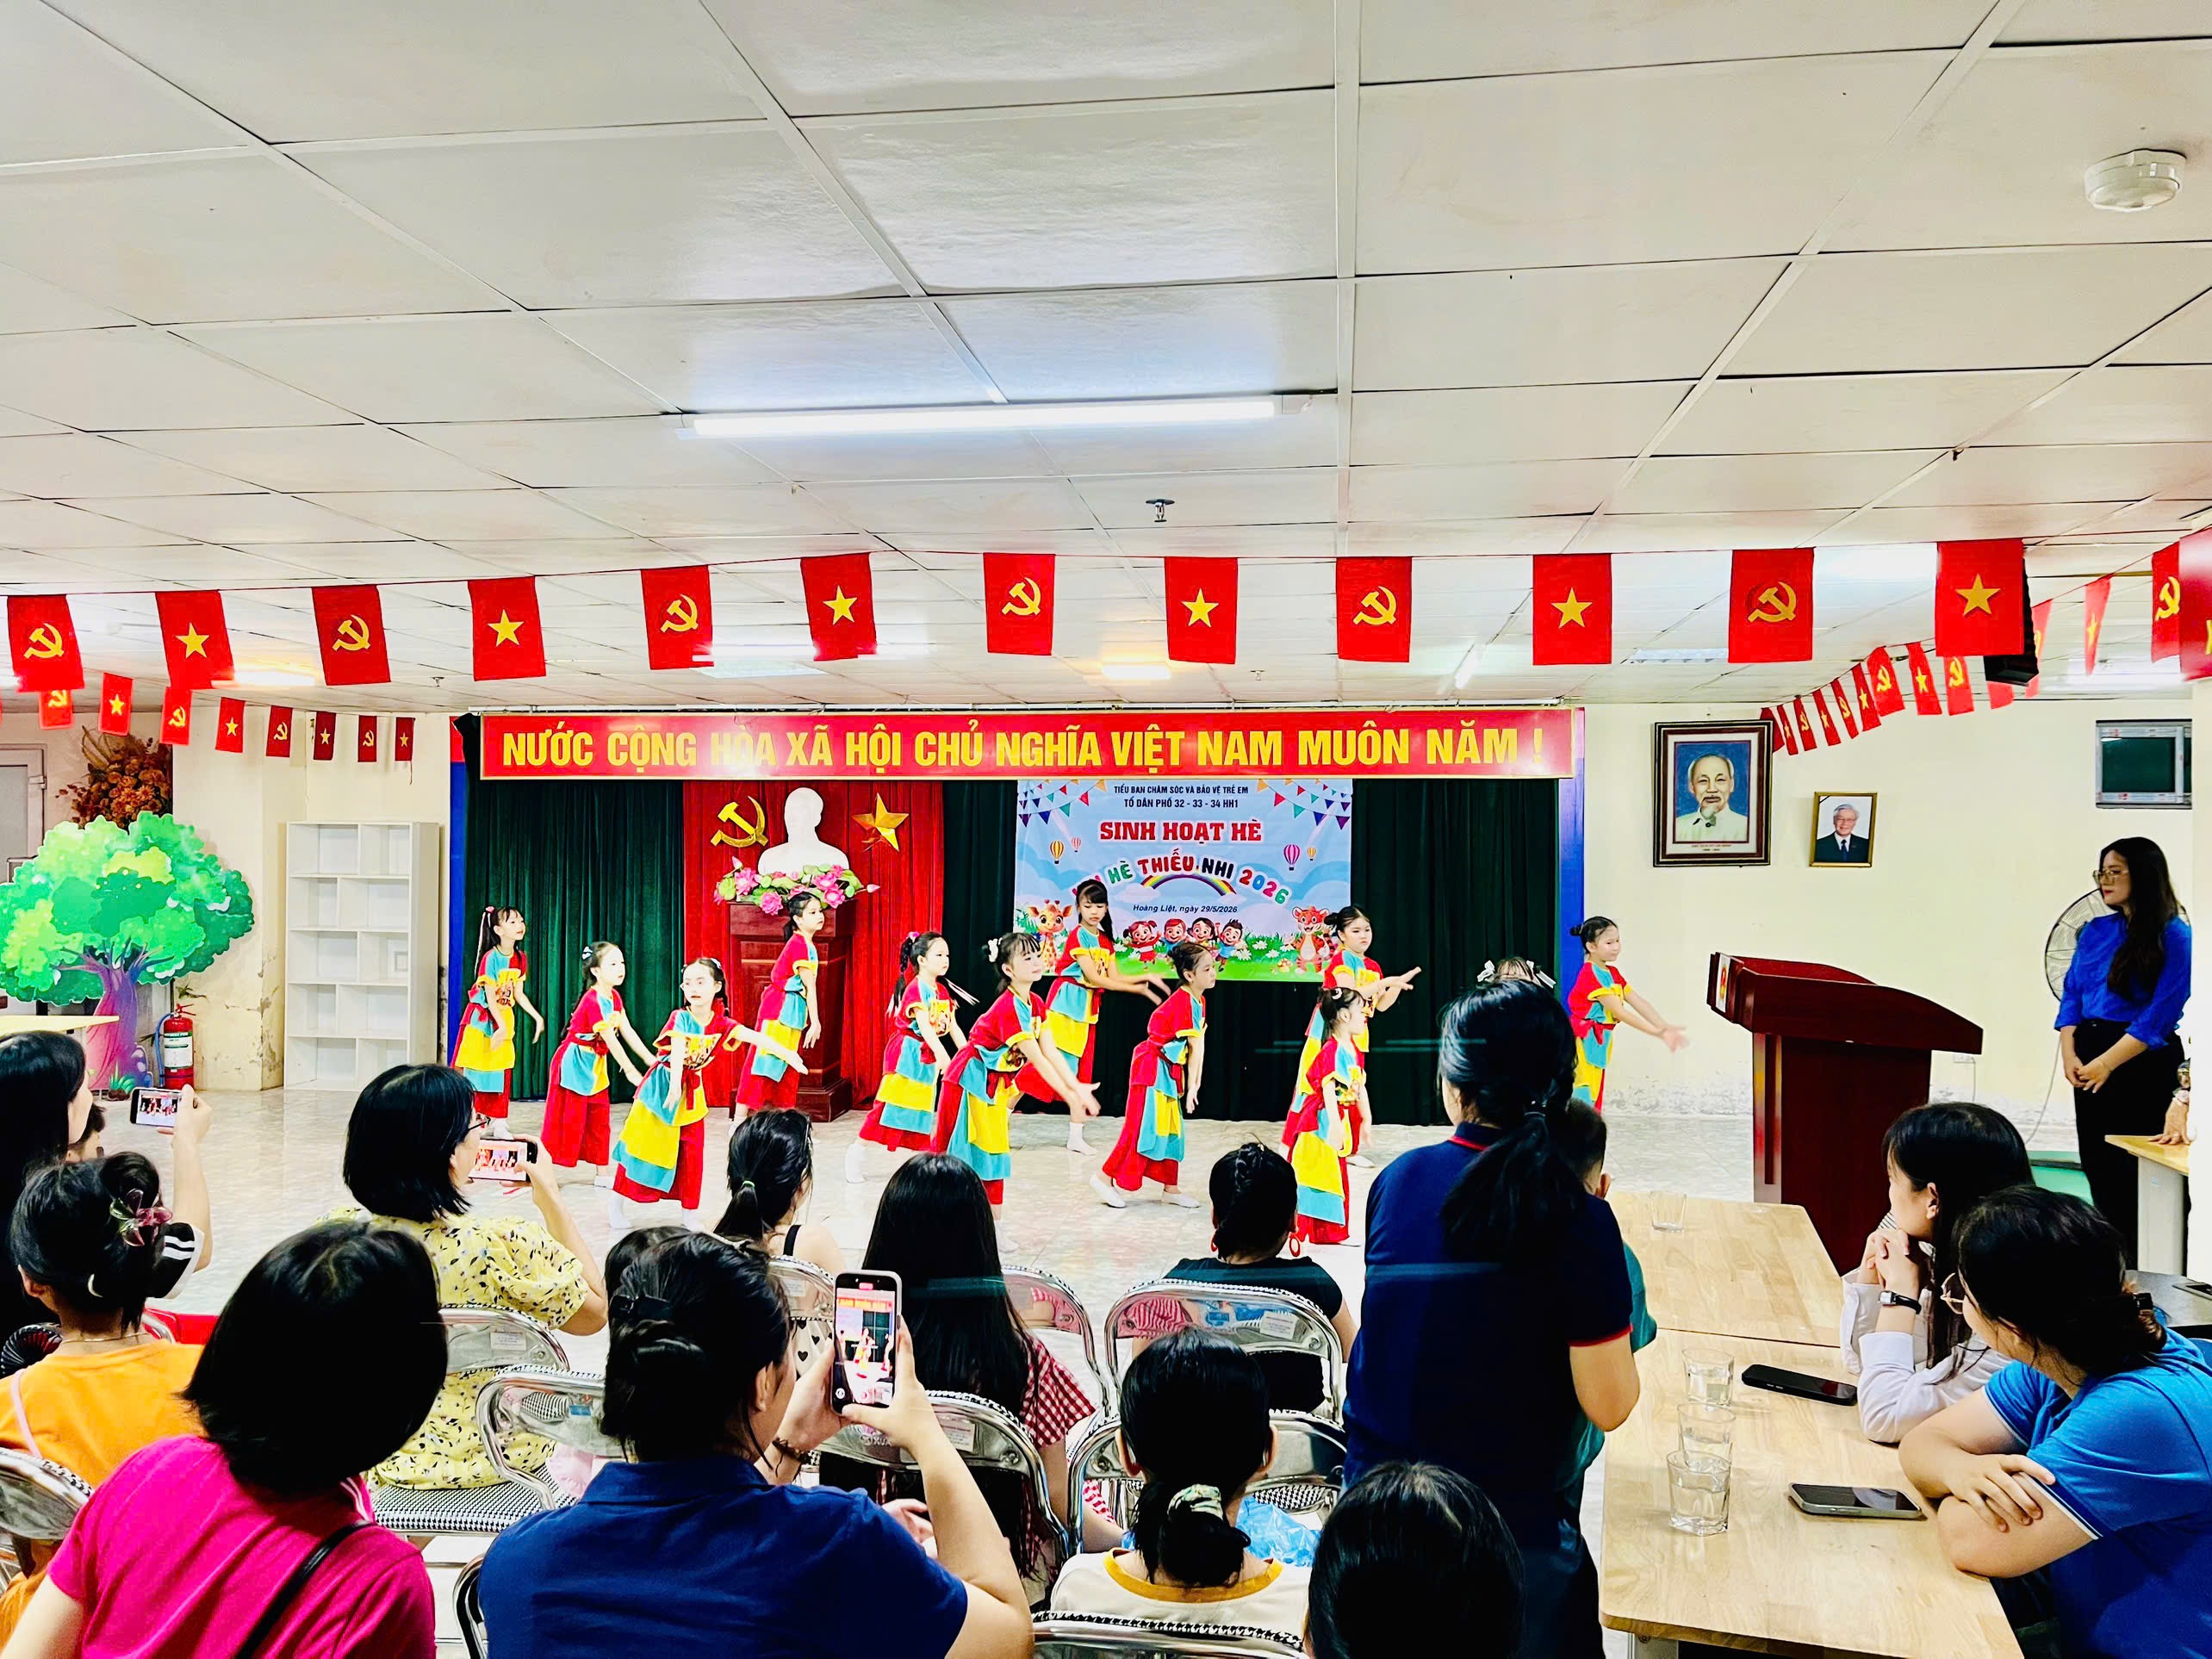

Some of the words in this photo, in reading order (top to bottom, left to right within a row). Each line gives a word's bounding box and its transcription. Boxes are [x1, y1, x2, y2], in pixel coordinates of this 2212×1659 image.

[503, 721, 593, 766] NƯỚC
[607, 724, 697, 773] CỘNG
[711, 724, 777, 766] HÒA
[786, 724, 834, 766] XÃ
[846, 724, 902, 774] HỘI
[915, 719, 984, 767] CHỦ
[996, 724, 1103, 767] NGHĨA
[1111, 724, 1184, 774] VIỆT
[1197, 730, 1283, 766] NAM
[1297, 721, 1409, 766] MUÔN
[1426, 720, 1519, 765] NĂM
[1533, 728, 1543, 765] !
[1131, 786, 1146, 794] BAN
[1185, 785, 1195, 794] VÀ
[1196, 784, 1211, 794] BẢO
[1223, 784, 1236, 794] TRẺ
[1238, 786, 1249, 794] EM
[1137, 797, 1153, 808] DÂN
[1156, 796, 1172, 808] PHỐ
[1174, 798, 1185, 808] 32
[1192, 798, 1202, 808] 33
[1210, 798, 1221, 808] 34
[1222, 798, 1239, 808] HH1
[1100, 822, 1156, 841] SINH
[1162, 822, 1225, 844] HOẠT
[1231, 818, 1262, 842] HÈ
[1107, 861, 1134, 885] HÈ
[1137, 848, 1195, 875] THIẾU
[1201, 857, 1234, 879] NHI
[1239, 868, 1289, 904] 2026
[1133, 904, 1159, 913] Hoàng
[1179, 904, 1199, 914] ngày
